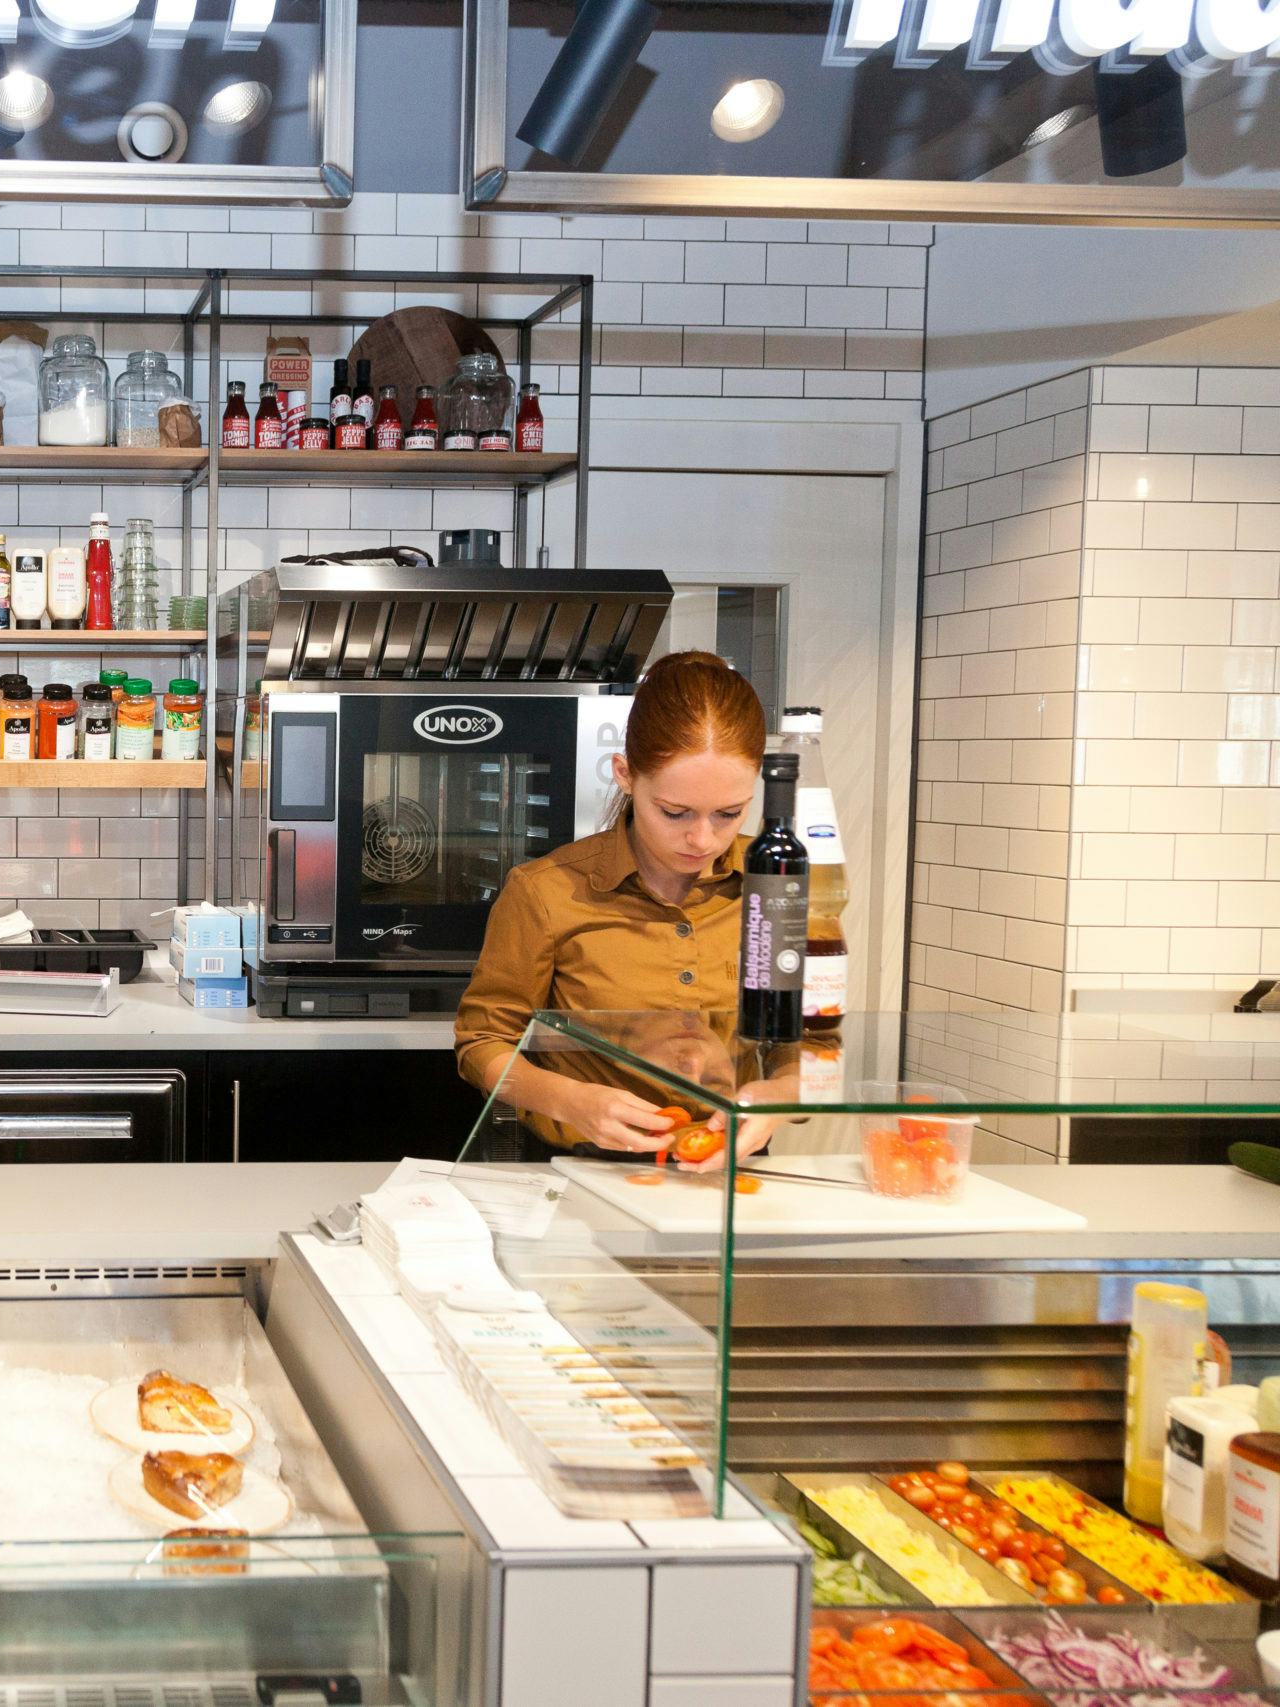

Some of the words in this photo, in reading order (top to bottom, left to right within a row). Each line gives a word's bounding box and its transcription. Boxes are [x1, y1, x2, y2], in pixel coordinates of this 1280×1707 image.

[271, 360, 308, 370] POWER
[271, 372, 308, 381] DRESSING
[303, 439, 323, 449] JELLY
[341, 436, 362, 445] JELLY
[377, 439, 398, 449] SAUCE
[522, 438, 542, 447] SAUCE
[423, 717, 487, 733] UNOX
[393, 928, 413, 936] Maps
[744, 893, 764, 990] Balsamique
